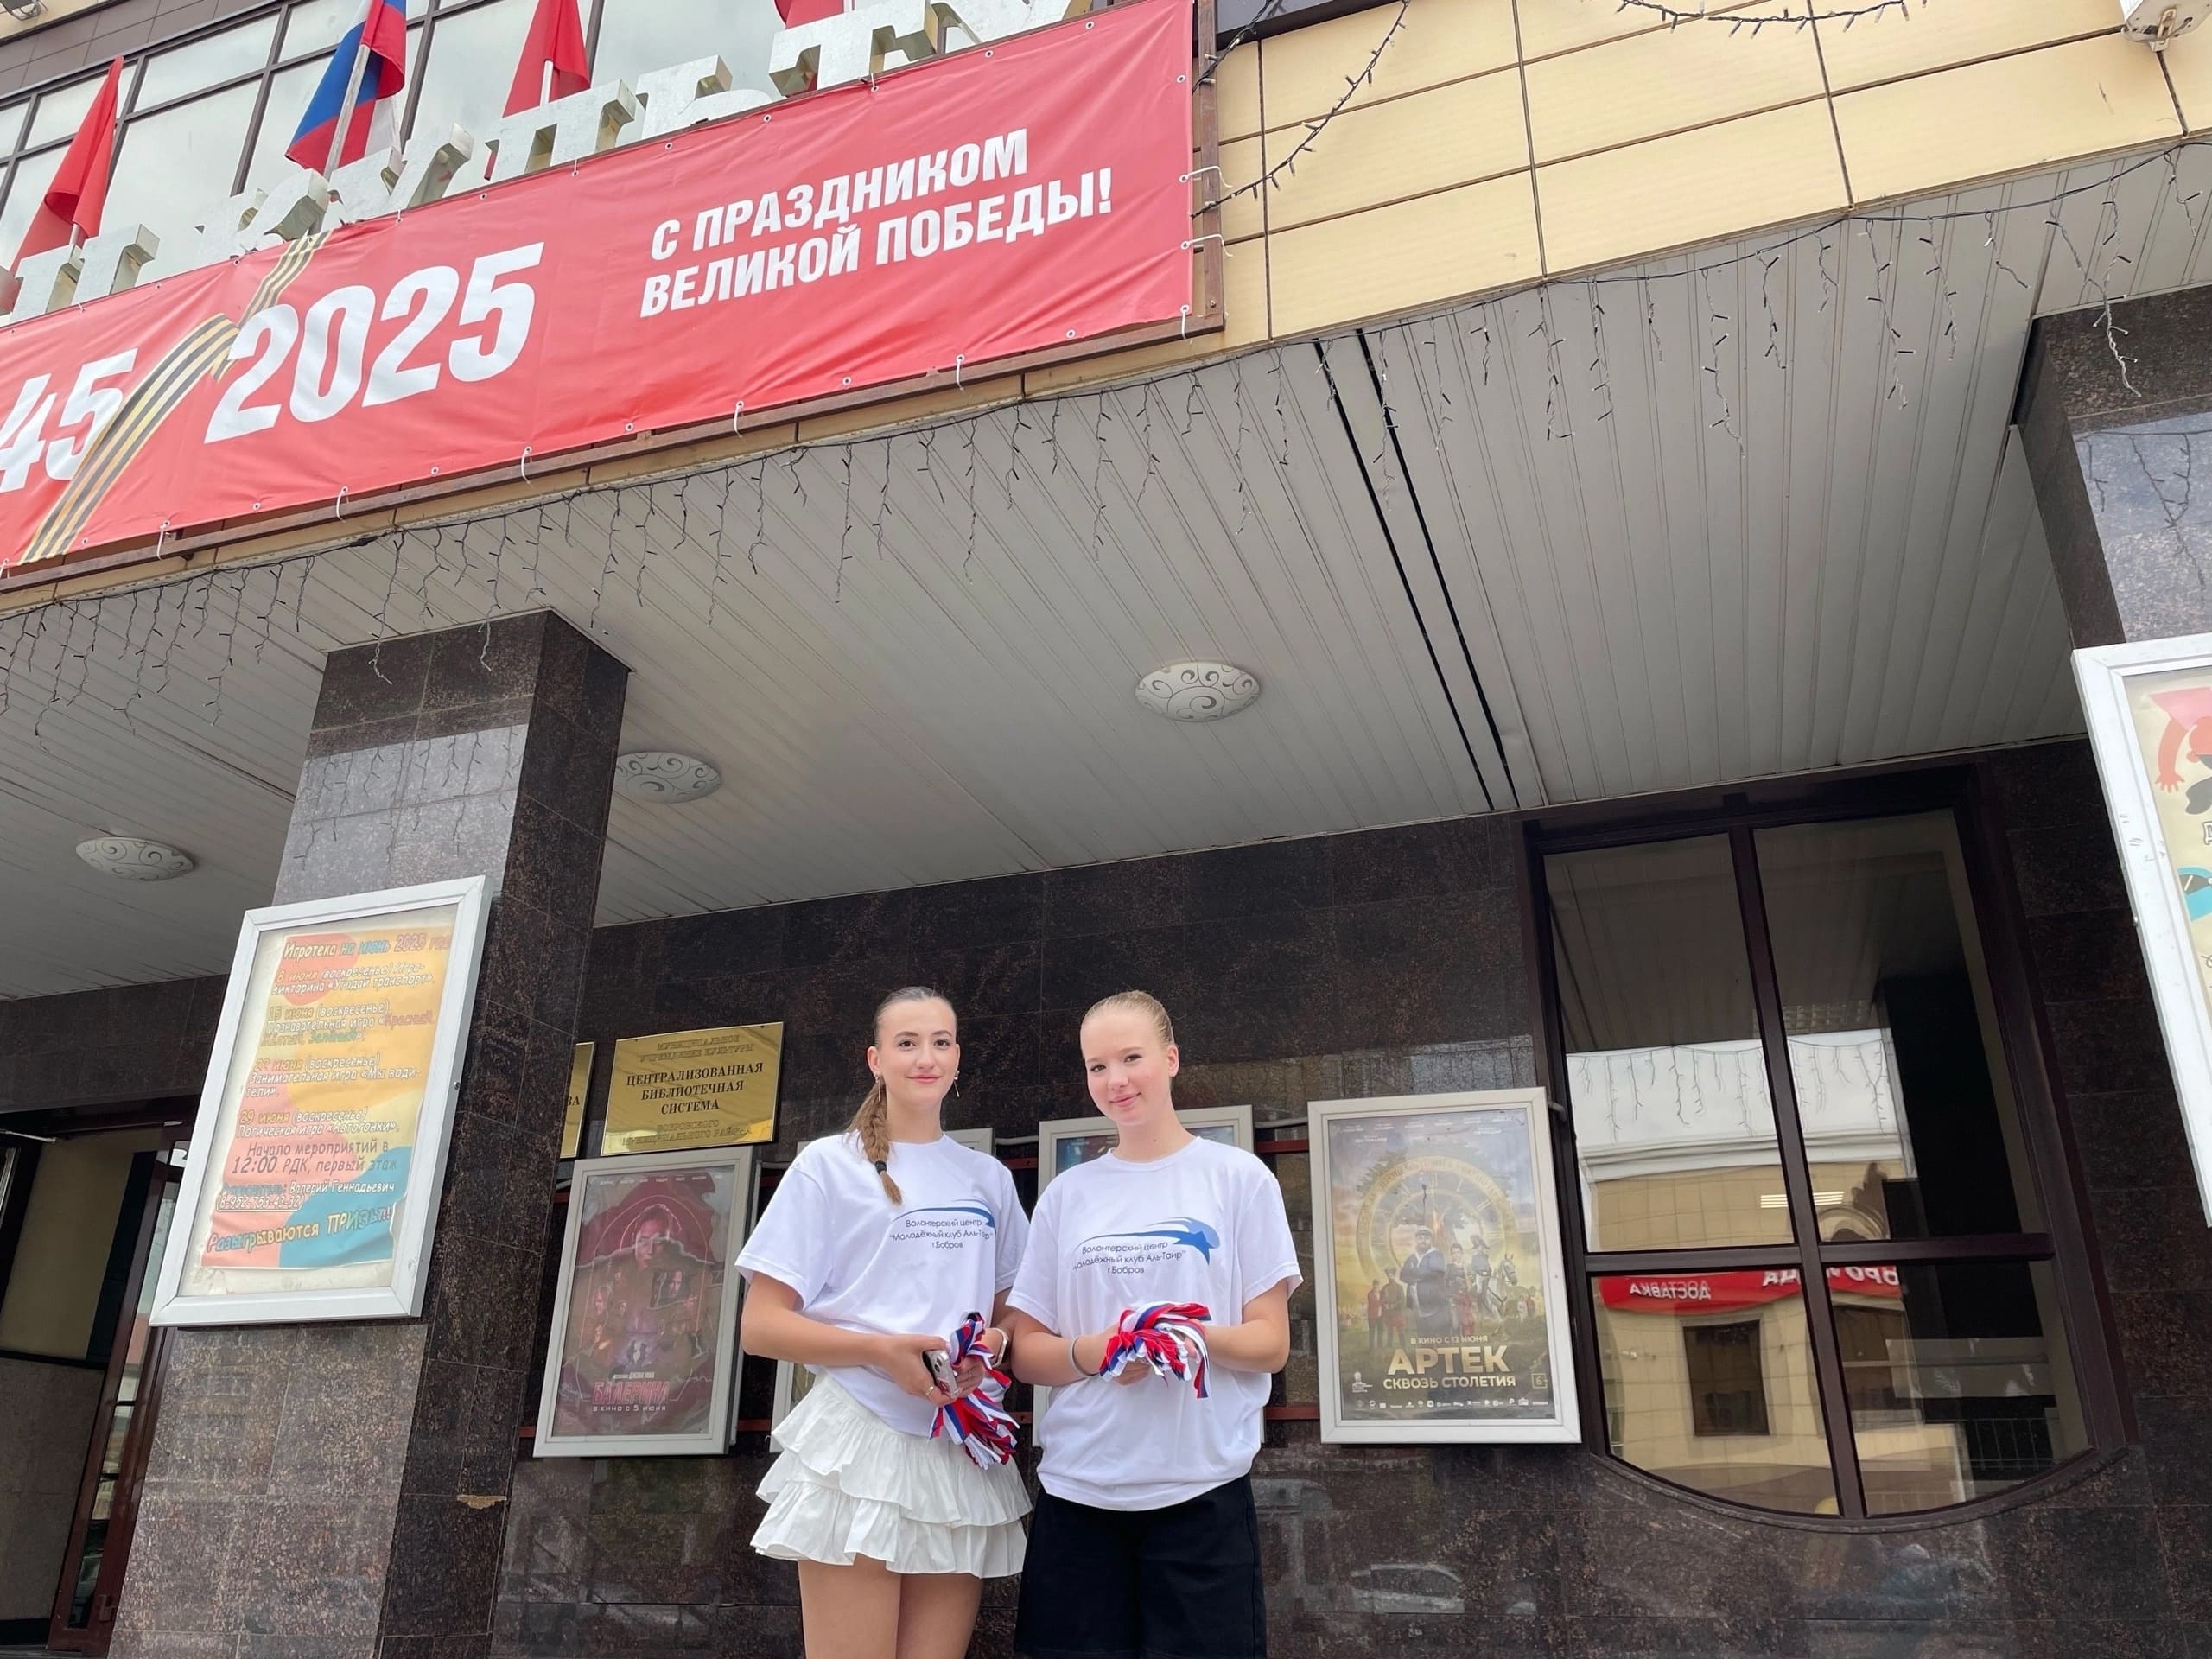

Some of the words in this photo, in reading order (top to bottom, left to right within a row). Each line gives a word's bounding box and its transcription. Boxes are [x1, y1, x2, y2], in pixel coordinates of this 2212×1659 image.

[651, 219, 680, 261] С
[692, 128, 1027, 252] ПРАЗДНИКОМ
[640, 226, 861, 318] ВЕЛИКОЙ
[875, 168, 1113, 265] ПОБЕДЫ!
[204, 242, 544, 444] 2025
[283, 941, 337, 964] Игротека
[340, 943, 356, 957] на
[276, 970, 284, 983] 8
[289, 971, 318, 982] июня
[272, 982, 326, 995] викторина
[269, 1007, 282, 1020] 15
[285, 1007, 313, 1019] июня
[316, 999, 390, 1019] (воскресенье)
[350, 1017, 375, 1030] игра
[254, 1058, 270, 1072] 22
[272, 1058, 302, 1071] июня
[304, 1052, 380, 1071] (воскресенье)
[248, 1072, 328, 1085] Занимательная
[332, 1070, 357, 1084] игра
[626, 1062, 763, 1087] ЦЕНТРАЛИЗОВАННАЯ
[641, 1080, 744, 1101] БИБЛИОТЕЧНАЯ
[239, 1109, 255, 1124] 29
[258, 1112, 290, 1124] июня
[293, 1106, 368, 1123] (воскресенье)
[661, 1099, 720, 1115] СИСТЕМА
[298, 1124, 325, 1137] игра
[248, 1142, 290, 1159] Начало
[295, 1139, 378, 1159] мероприятий
[382, 1141, 389, 1153] в
[315, 1158, 365, 1175] первый
[369, 1159, 397, 1171] этаж
[289, 1180, 328, 1195] Валерий
[331, 1180, 395, 1193] Геннадьевич
[906, 1219, 958, 1229] Волонтерский
[960, 1219, 982, 1228] центр
[207, 1223, 320, 1253] Разыгрываются
[944, 1230, 962, 1239] клуб
[1082, 1244, 1141, 1255] Волонтерский
[1143, 1241, 1168, 1251] центр
[1124, 1255, 1145, 1264] клуб
[1418, 1336, 1443, 1344] КИНО
[1461, 1335, 1488, 1344] ИЮНЯ
[1387, 1344, 1510, 1376] АРТЕК
[1382, 1376, 1438, 1389] СКВОЗЬ
[1441, 1375, 1516, 1389] СТОЛЕТИЯ
[592, 1381, 670, 1405] БАЛЕРИНА
